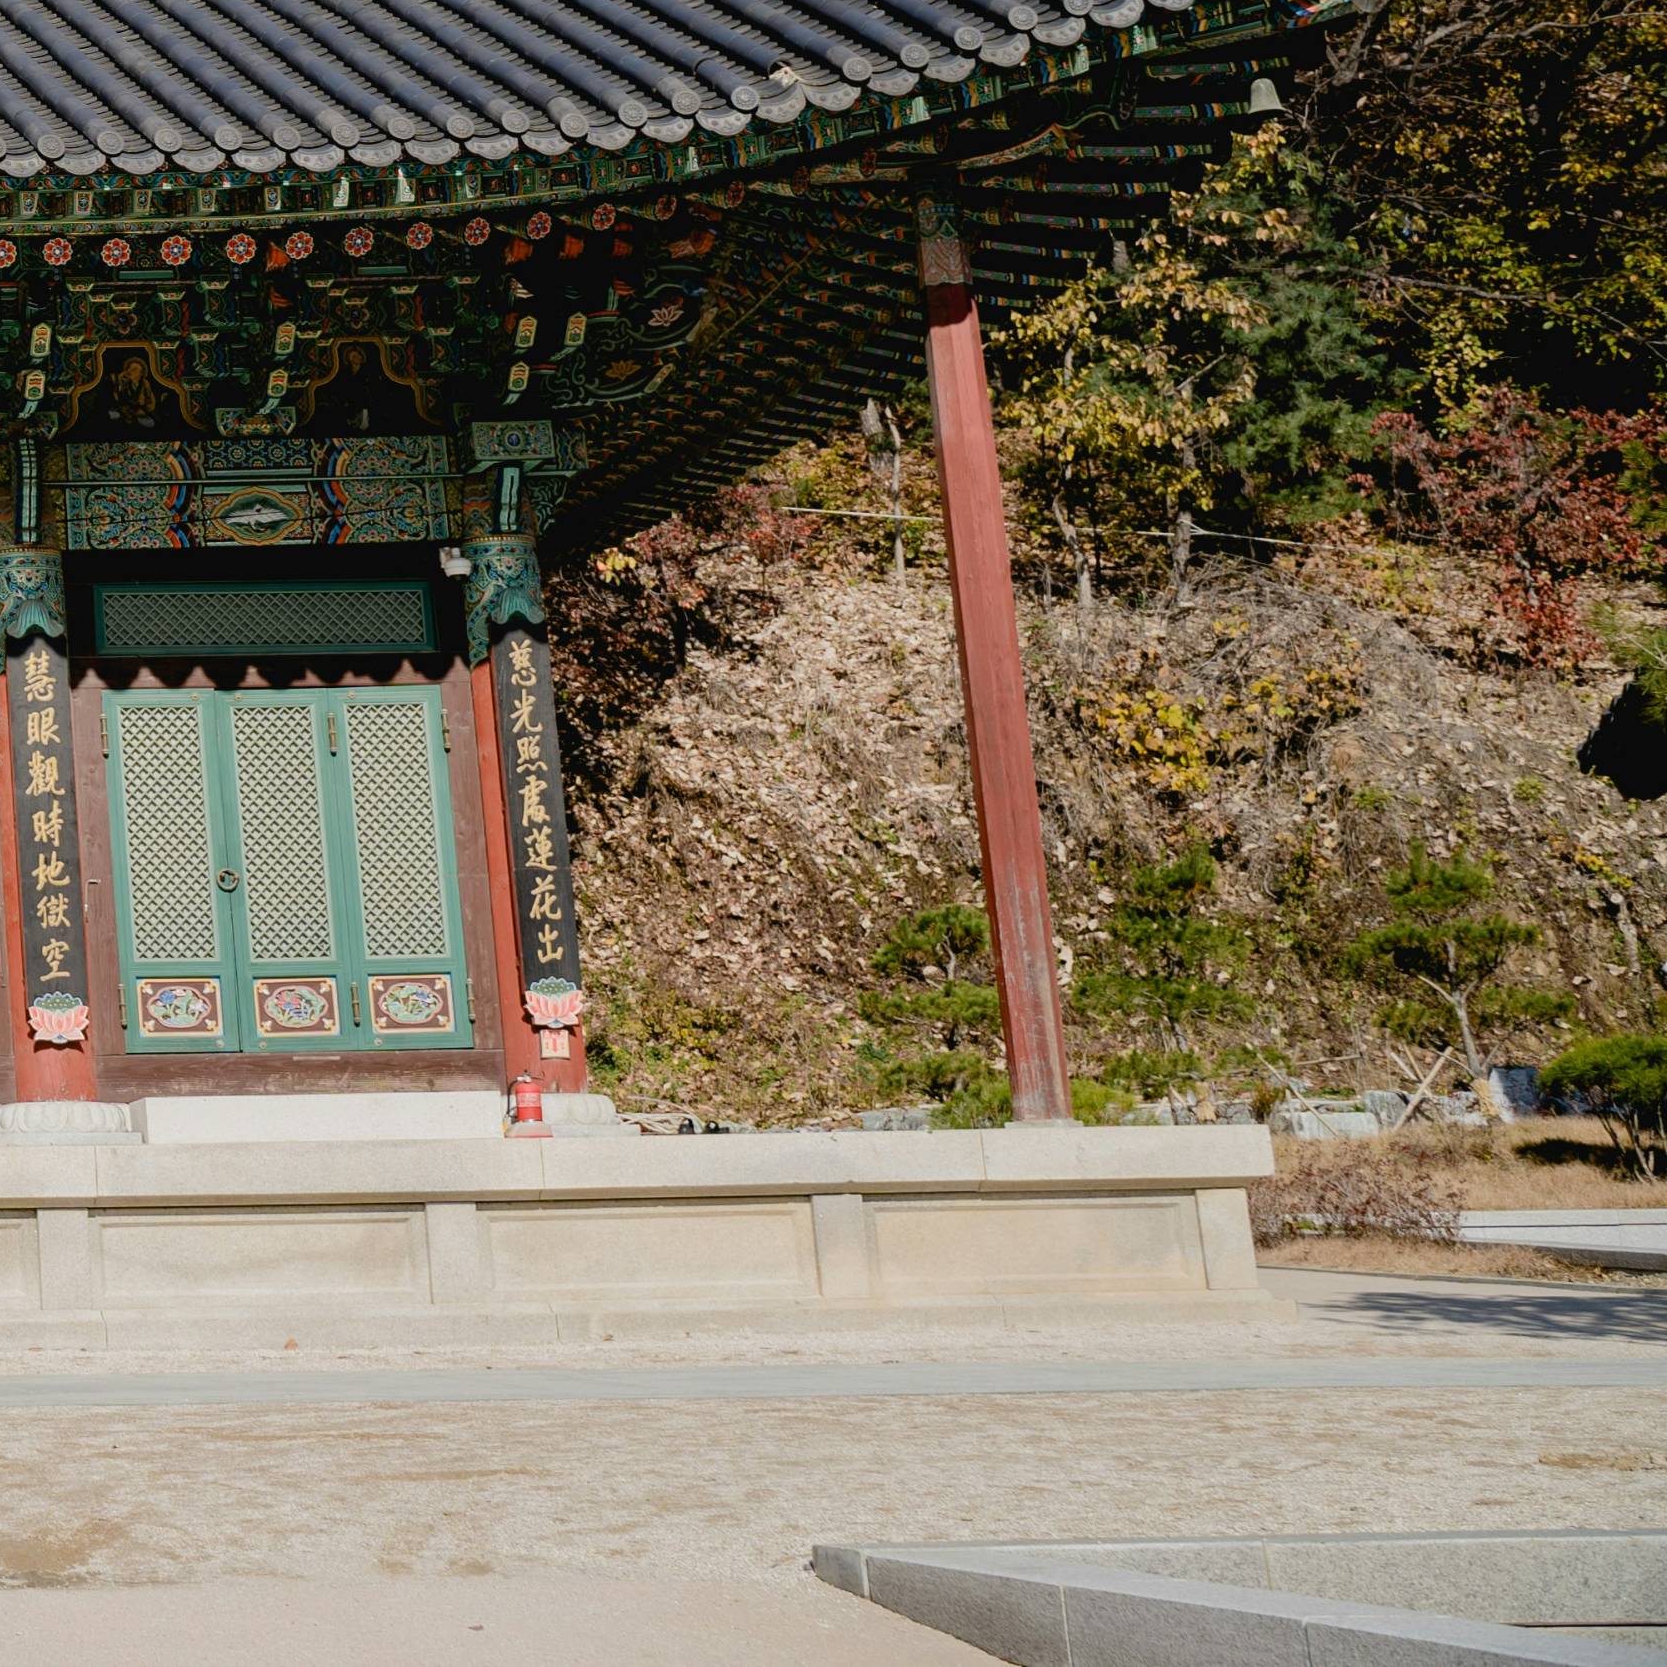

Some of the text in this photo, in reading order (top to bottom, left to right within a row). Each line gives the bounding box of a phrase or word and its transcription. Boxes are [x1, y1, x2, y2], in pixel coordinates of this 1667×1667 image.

[23, 651, 71, 981] 慧眼觀時地獄空
